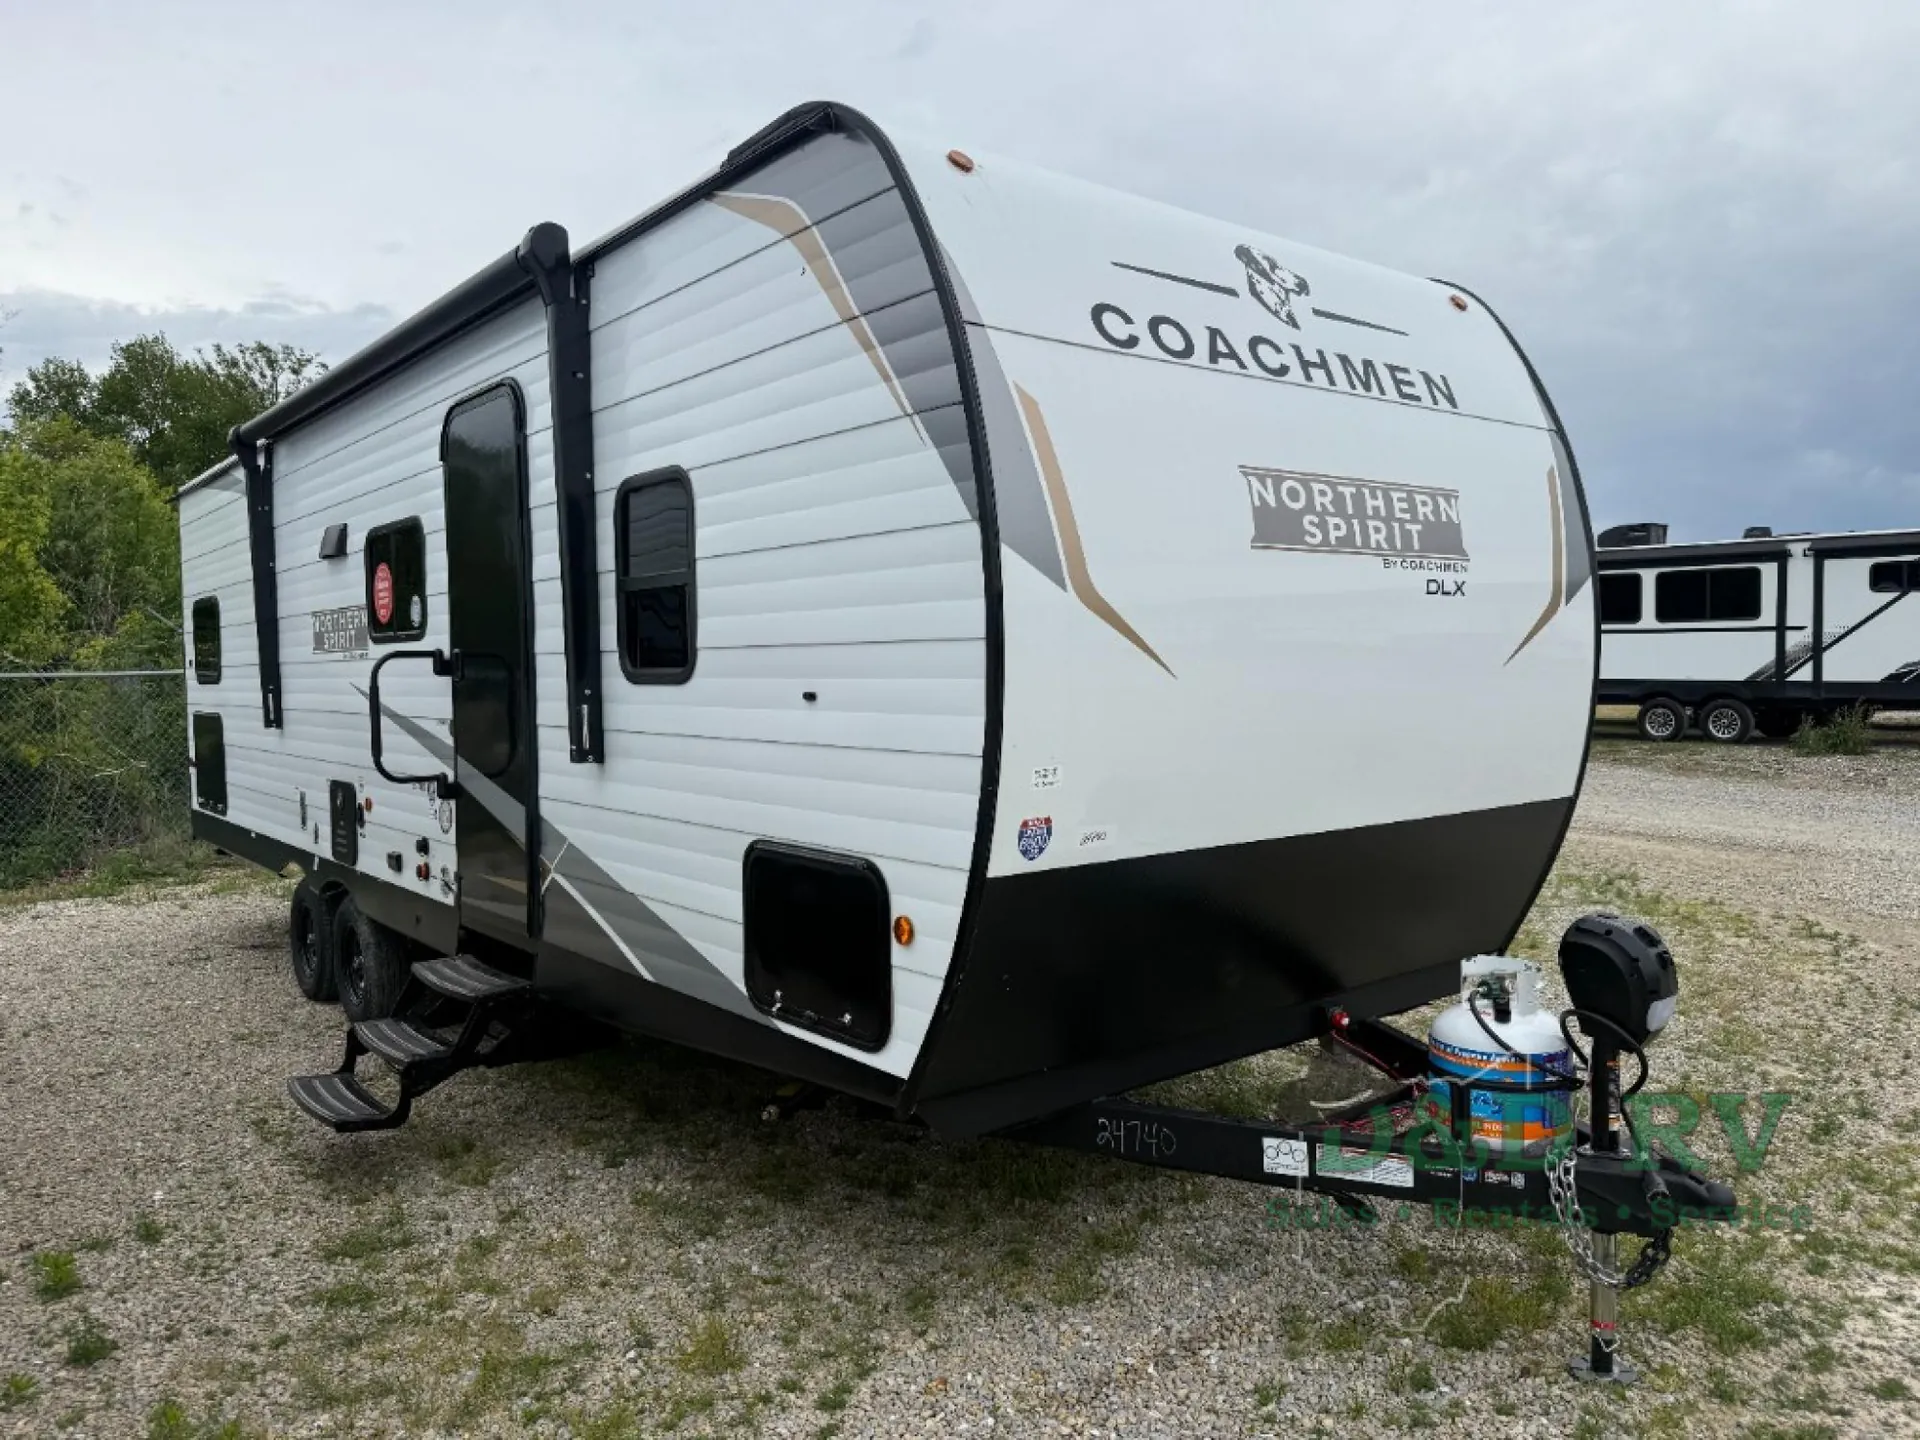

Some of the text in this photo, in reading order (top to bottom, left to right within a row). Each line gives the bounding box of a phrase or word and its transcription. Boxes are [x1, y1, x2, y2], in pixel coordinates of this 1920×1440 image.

[1090, 302, 1459, 410] COACHMEN
[1248, 474, 1460, 524] NORTHERN
[1302, 514, 1422, 550] SPIRIT
[1382, 558, 1468, 573] BY COACHMEN
[1425, 579, 1467, 596] DLX
[312, 610, 368, 632] NORTHERN
[323, 630, 356, 650] SPIRIT
[1096, 1117, 1177, 1157] 24740
